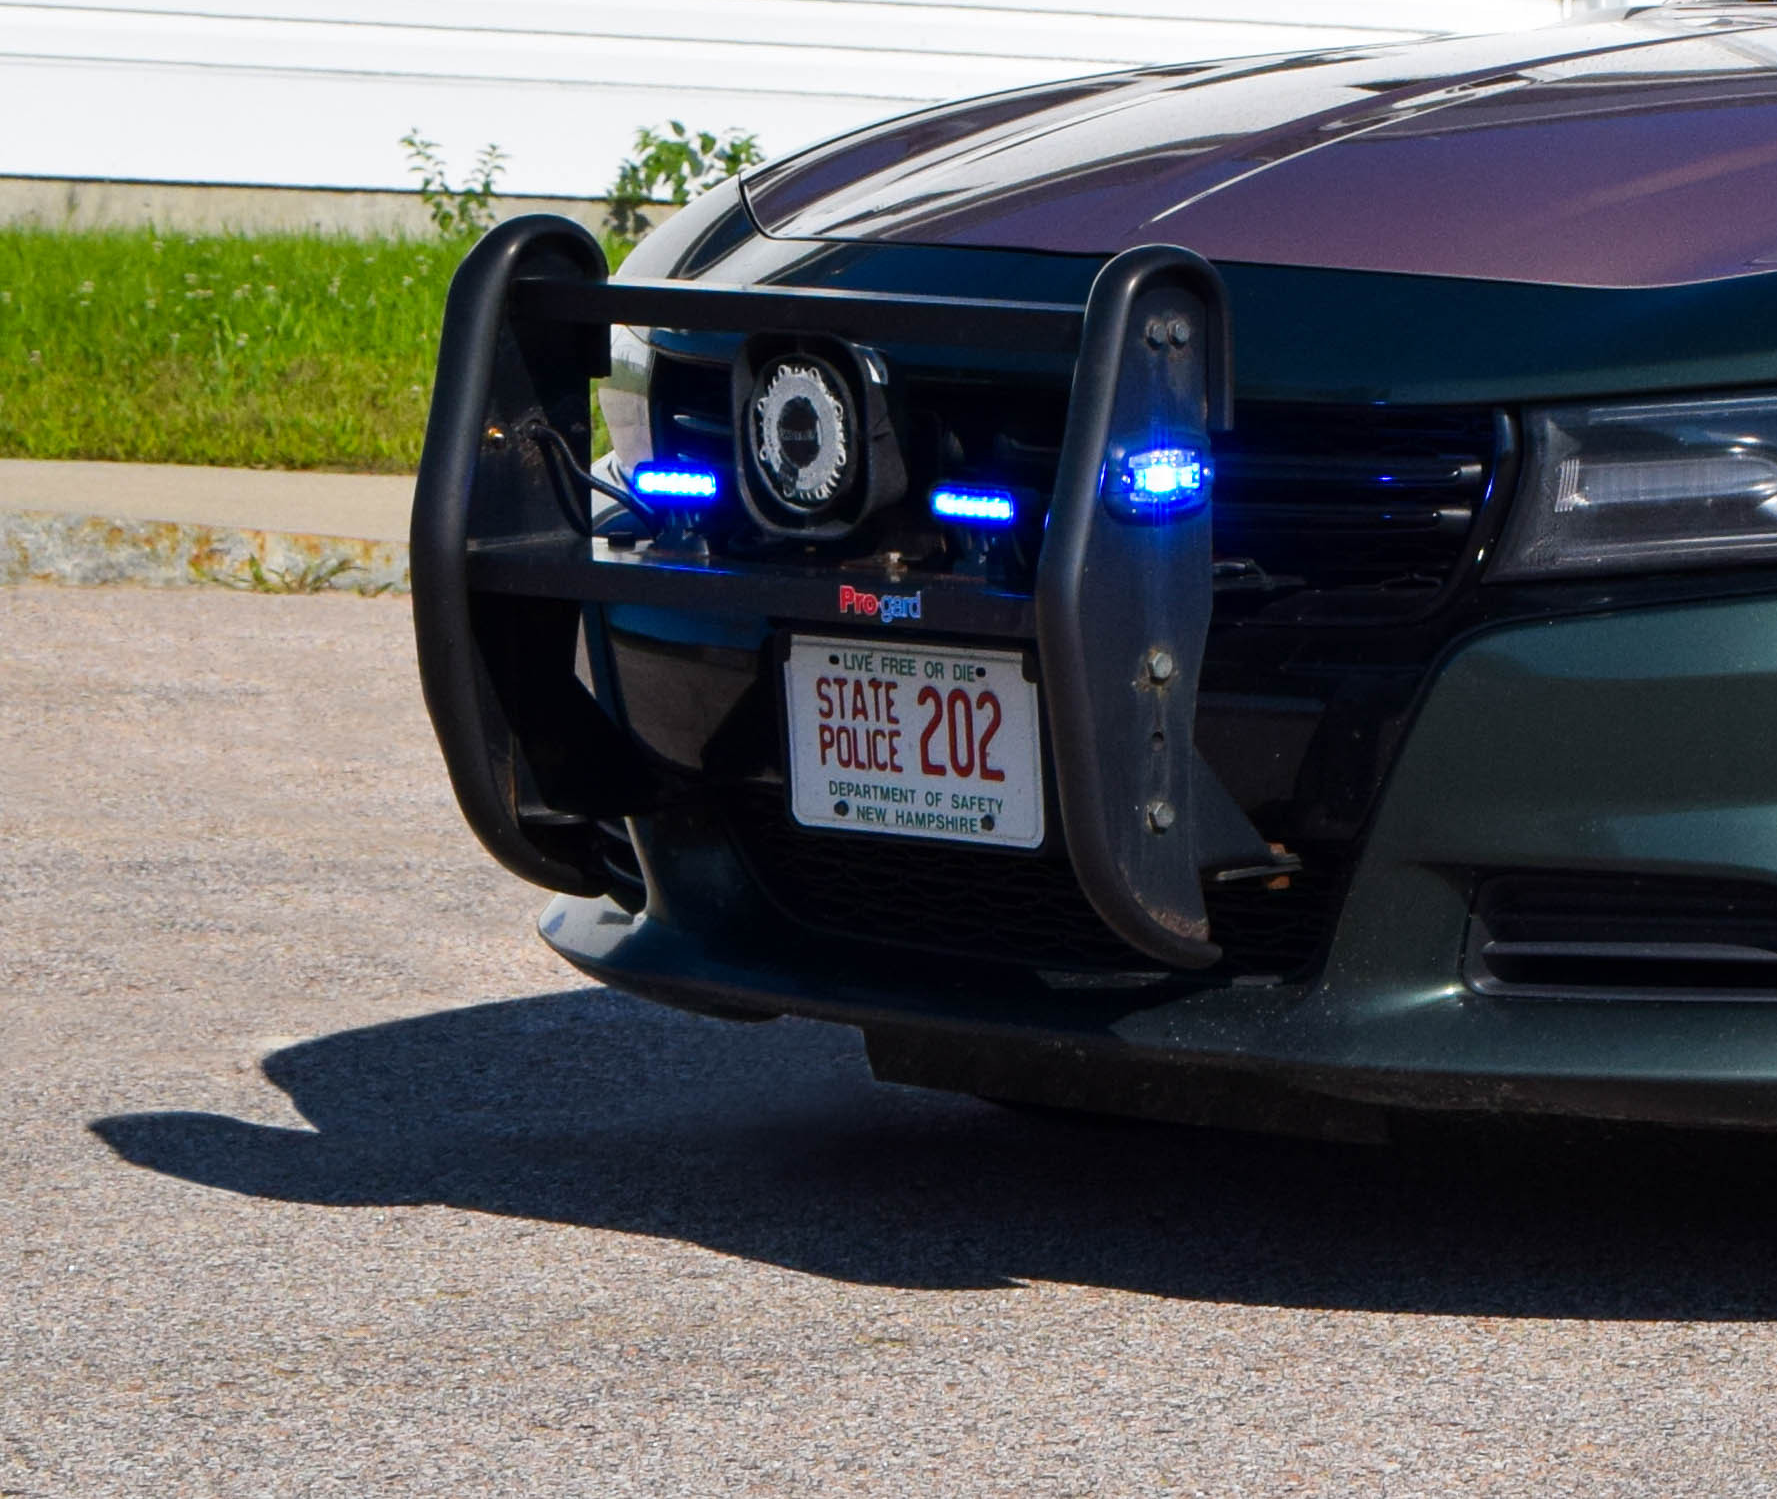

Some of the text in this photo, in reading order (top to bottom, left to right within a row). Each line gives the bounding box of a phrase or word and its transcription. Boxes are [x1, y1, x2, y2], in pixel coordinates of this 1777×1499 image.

[843, 652, 976, 682] LIVE FREE OR DIE
[816, 677, 900, 724] STATE
[819, 723, 904, 773] POLICE
[917, 685, 1005, 782] 202
[828, 780, 1004, 814] DEPARTMENT OF SAFETY
[856, 804, 979, 833] NEW HAMPSHIRE
